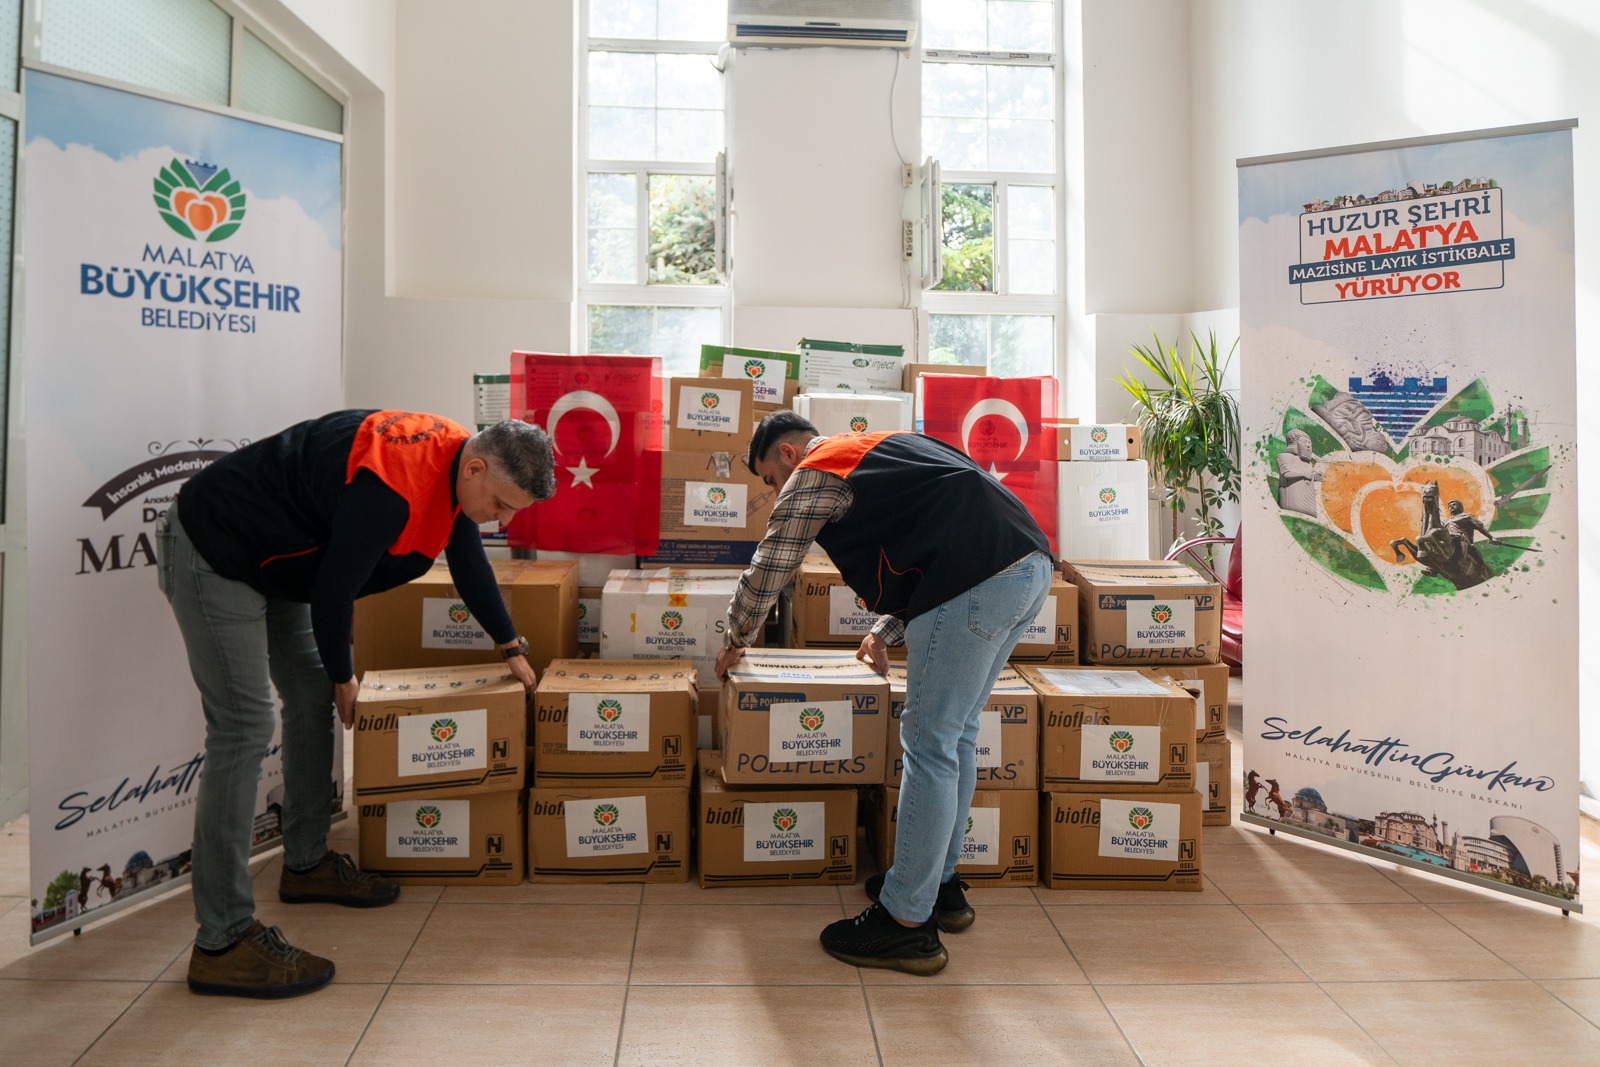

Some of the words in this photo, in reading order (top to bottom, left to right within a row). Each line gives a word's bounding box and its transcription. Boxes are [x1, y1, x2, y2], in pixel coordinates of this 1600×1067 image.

[1307, 208, 1400, 237] HUZUR
[1408, 191, 1491, 228] ŞEHRİ
[1323, 220, 1479, 261] MALATYA
[142, 242, 255, 274] MALATYA
[1292, 261, 1366, 281] MAZİSİNE
[1371, 253, 1417, 271] LAYIK
[1421, 243, 1511, 265] İSTİKBALE
[1335, 271, 1461, 300] YÜRÜYOR
[871, 358, 895, 371] inject
[1047, 710, 1111, 728] biofleks
[55, 752, 205, 830] Selahatt
[1285, 751, 1331, 767] MALATYA
[1470, 793, 1523, 811] BAŞKANI
[86, 816, 139, 838] MALATYA
[1055, 807, 1100, 825] biofle
